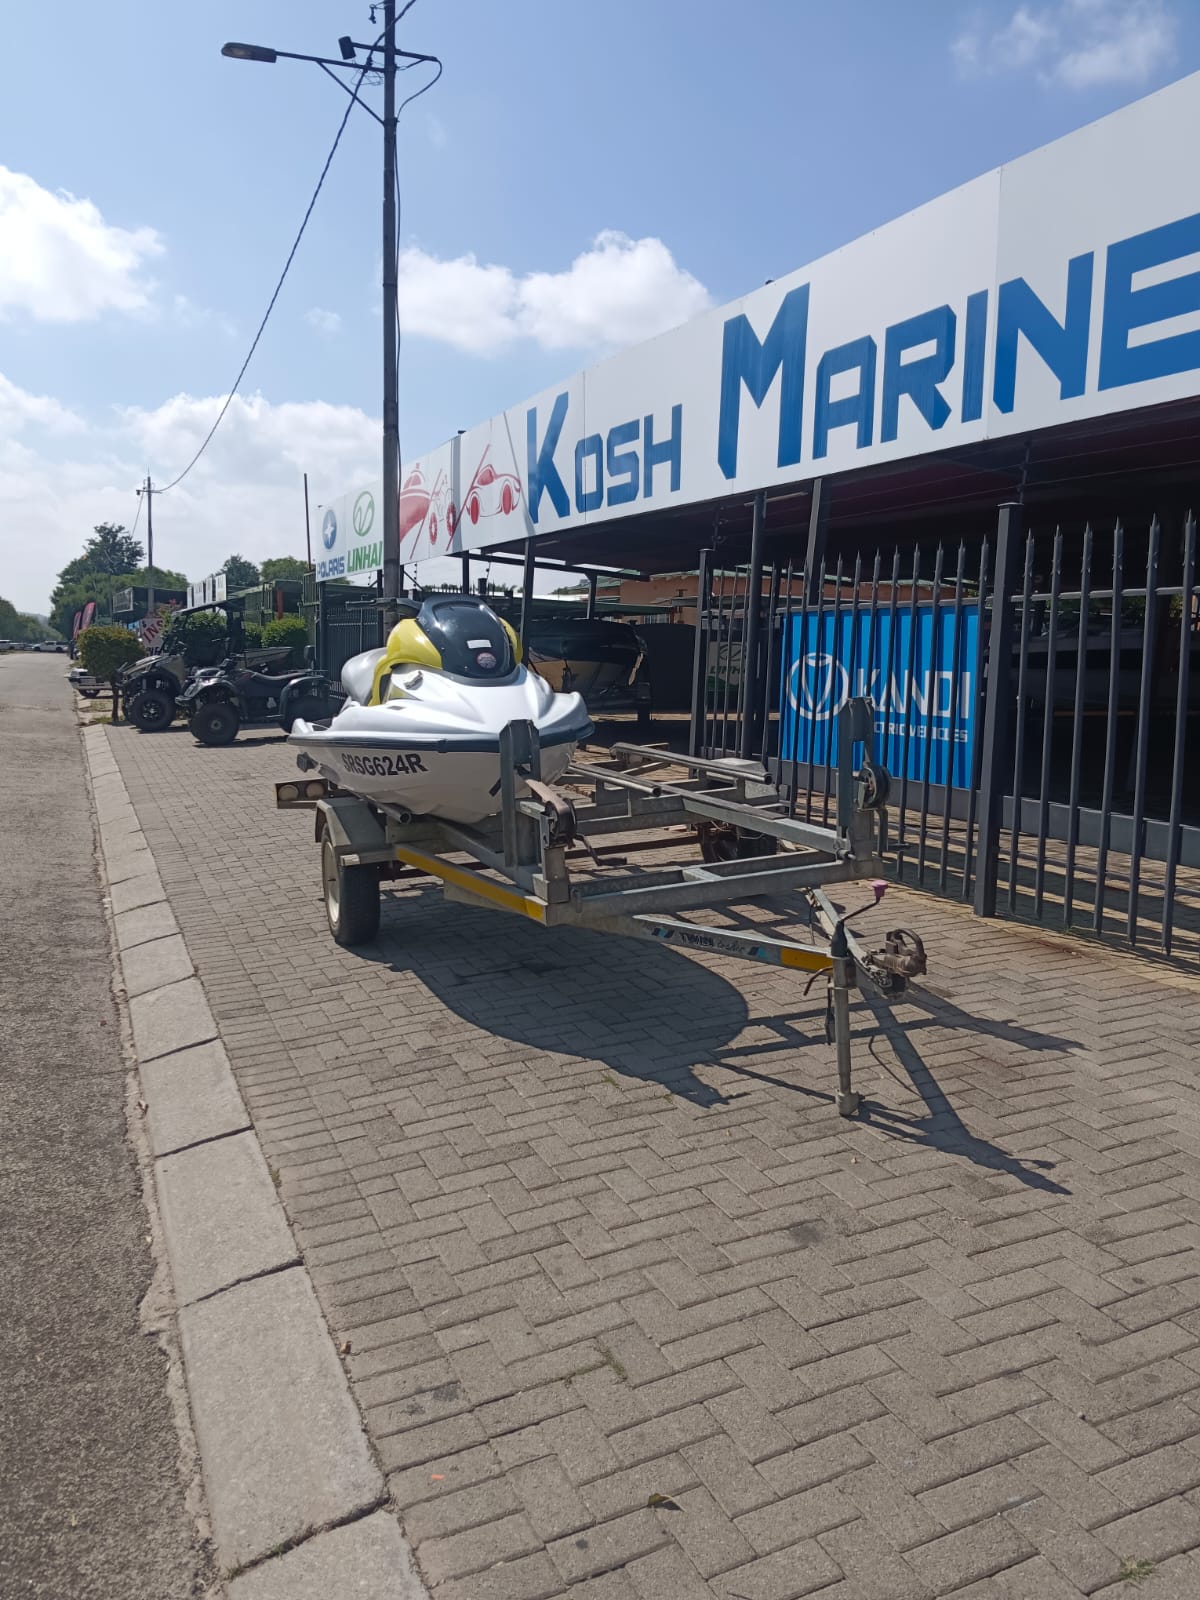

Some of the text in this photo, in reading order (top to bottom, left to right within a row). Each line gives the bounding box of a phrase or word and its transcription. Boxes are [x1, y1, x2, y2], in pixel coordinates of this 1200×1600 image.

[526, 212, 1200, 524] KOSH MARINE
[857, 668, 970, 719] KANDI
